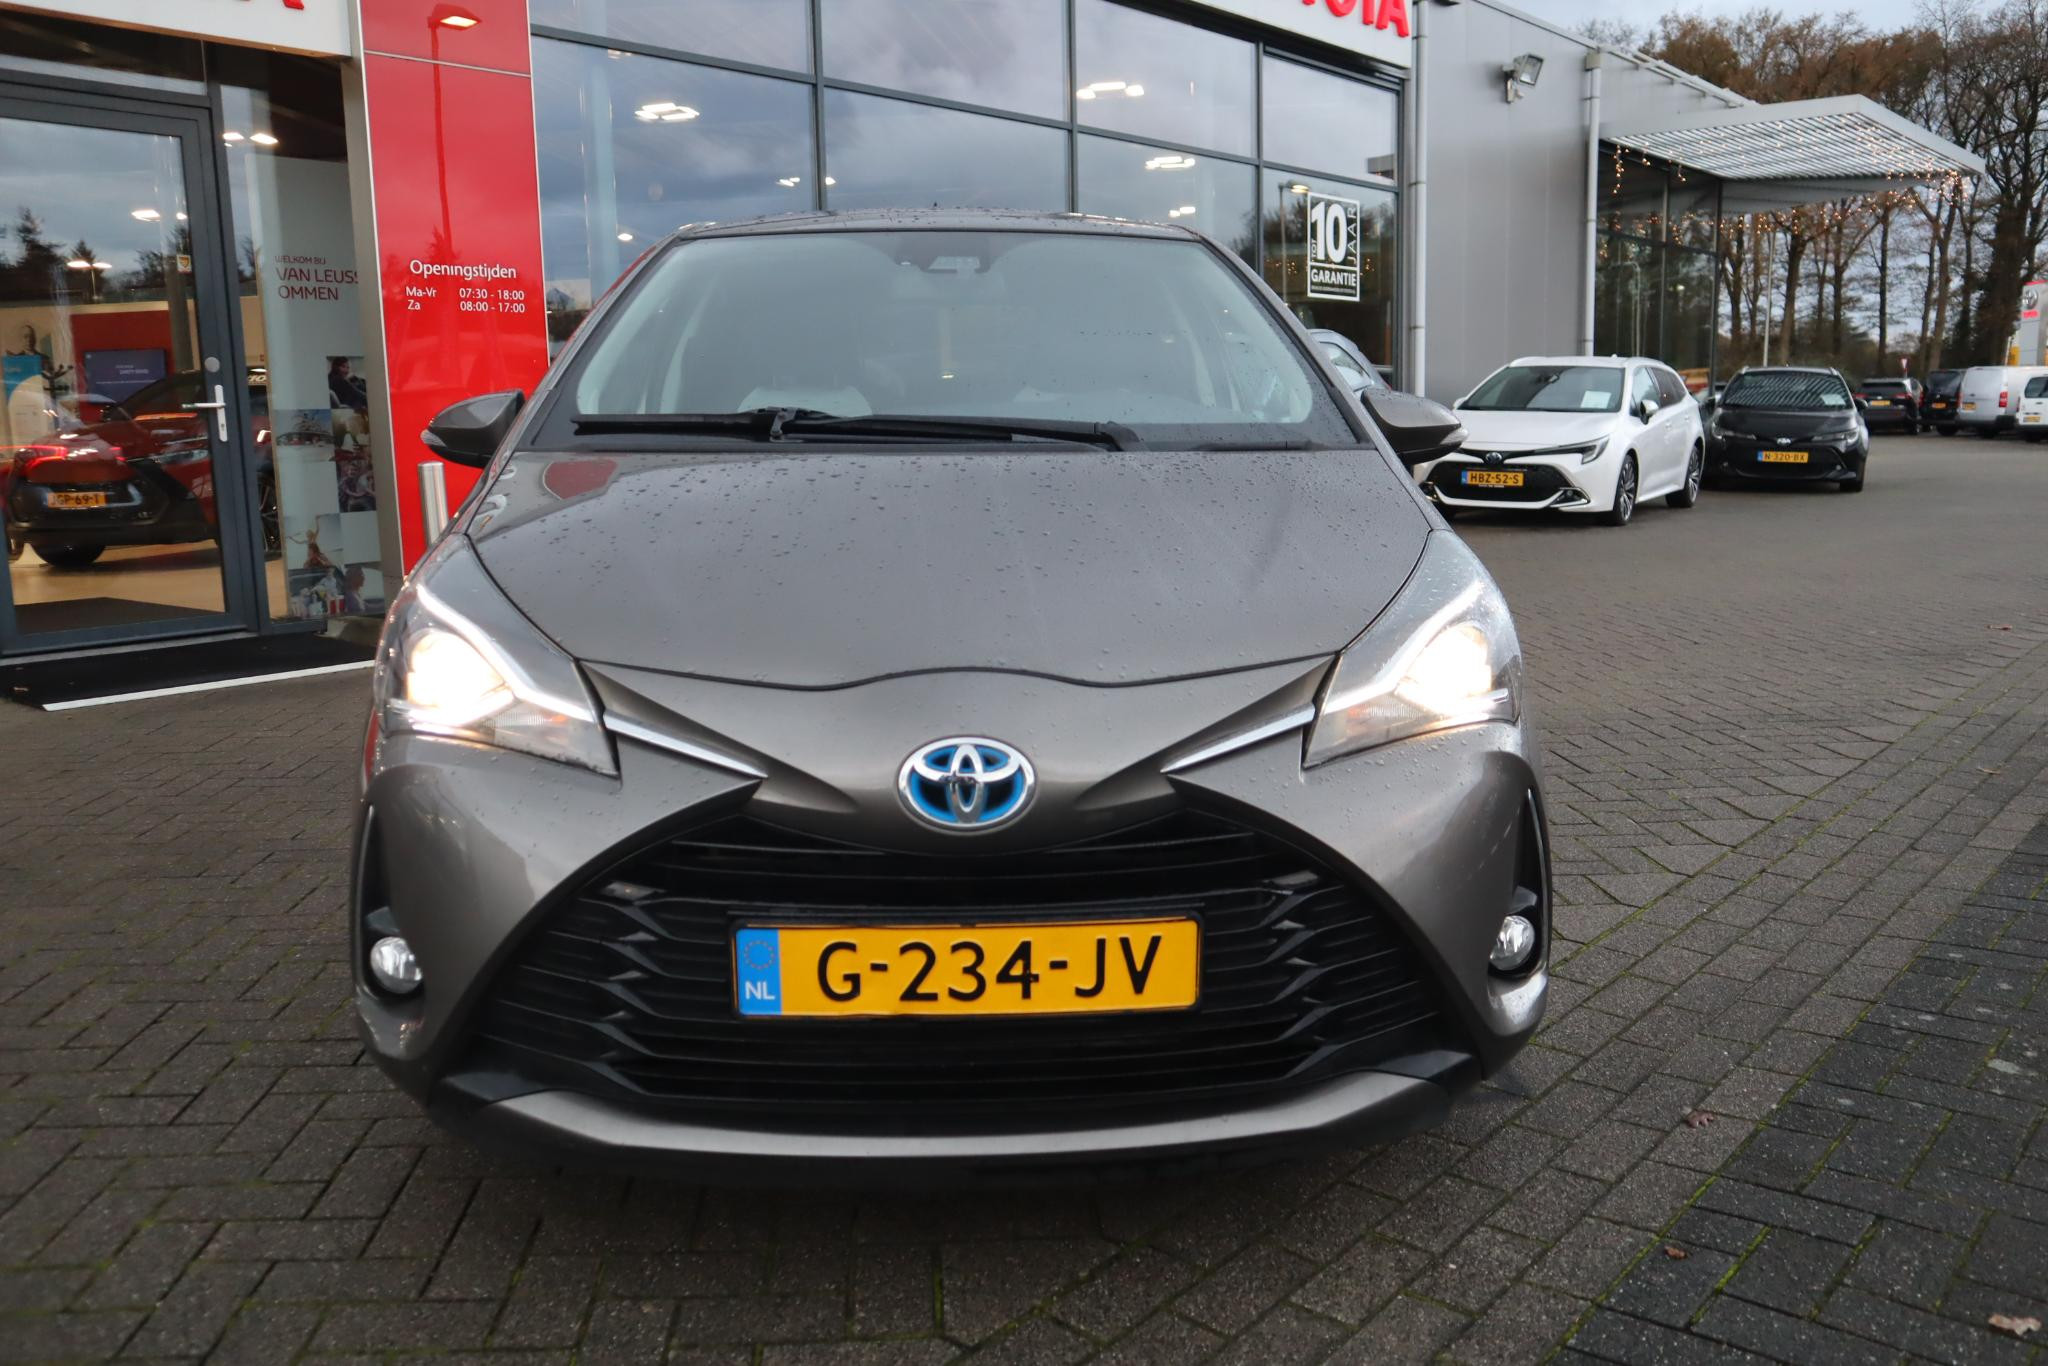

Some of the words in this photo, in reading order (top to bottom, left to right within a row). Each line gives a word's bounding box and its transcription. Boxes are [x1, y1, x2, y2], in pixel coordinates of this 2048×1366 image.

[1311, 201, 1348, 264] 10
[1347, 207, 1357, 265] JAAR
[276, 267, 310, 281] VAN
[409, 259, 517, 282] Openingstijden
[1311, 268, 1357, 287] GARANTIE
[278, 285, 339, 300] OMMEN
[405, 286, 437, 298] Ma-Vr
[459, 287, 488, 299] 07:30
[497, 289, 525, 300] 18:00
[407, 299, 421, 310] Za
[460, 301, 489, 312] 08:00
[498, 302, 526, 313] 17:00
[1469, 472, 1519, 485] HBZ-52-S
[744, 981, 776, 1001] NL
[816, 935, 1163, 1002] G-234-JV
